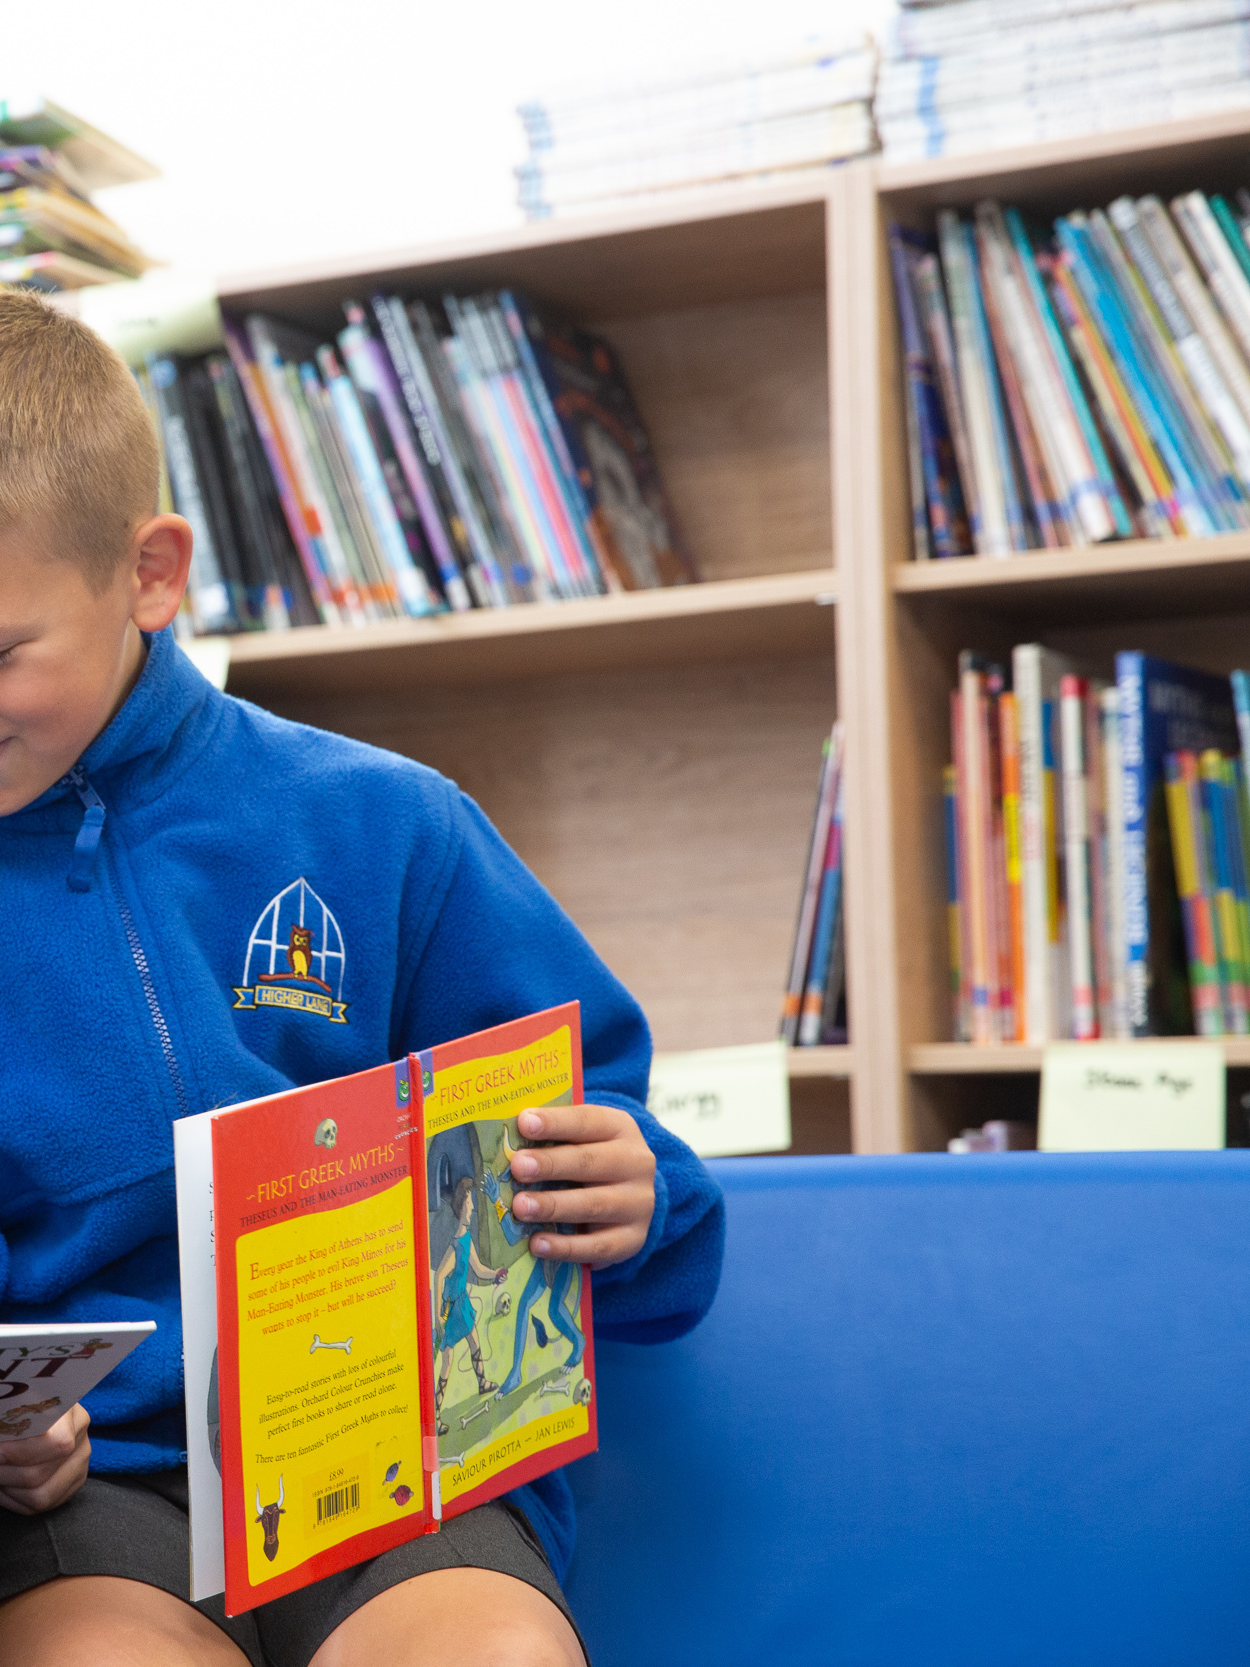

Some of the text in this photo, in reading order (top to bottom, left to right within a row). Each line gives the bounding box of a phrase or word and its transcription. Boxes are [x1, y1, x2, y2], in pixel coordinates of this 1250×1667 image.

[261, 989, 329, 1012] HIGHER LANE
[428, 1110, 458, 1130] THESEUS
[461, 1103, 476, 1118] AND
[477, 1098, 491, 1112] THE
[493, 1086, 535, 1110] MAN-EATING
[536, 1072, 569, 1092] MONSTER
[440, 1049, 559, 1106] FIRST GREEK MYTHS
[240, 1165, 408, 1227] THESEUS AND THE MAN-EATING MONSTER
[257, 1143, 394, 1202] FIRST GREEK MYTHS
[248, 1239, 406, 1300] some of his people to evil King Minos for his
[250, 1220, 403, 1280] Every year the King of Athens has to send
[247, 1258, 408, 1321] Man-Eating Monster. His brave son Theseus
[262, 1321, 285, 1335] wants
[286, 1318, 294, 1327] to
[296, 1311, 312, 1323] stop
[313, 1308, 319, 1317] it
[327, 1302, 340, 1313] but
[341, 1294, 354, 1307] will
[356, 1289, 364, 1301] he
[366, 1278, 396, 1298] succeed?
[259, 1363, 404, 1424] illustrations. Orchard Colour Crunchies make
[266, 1349, 397, 1405] Easy-to-read stories with lots of colourful
[255, 1404, 408, 1464] There are ten fantastic First Greek Myths to collect!
[267, 1382, 398, 1439] perfect first books to share or read alone.
[452, 1417, 575, 1486] SAVIOUR PIROTTA JAN LEWIS
